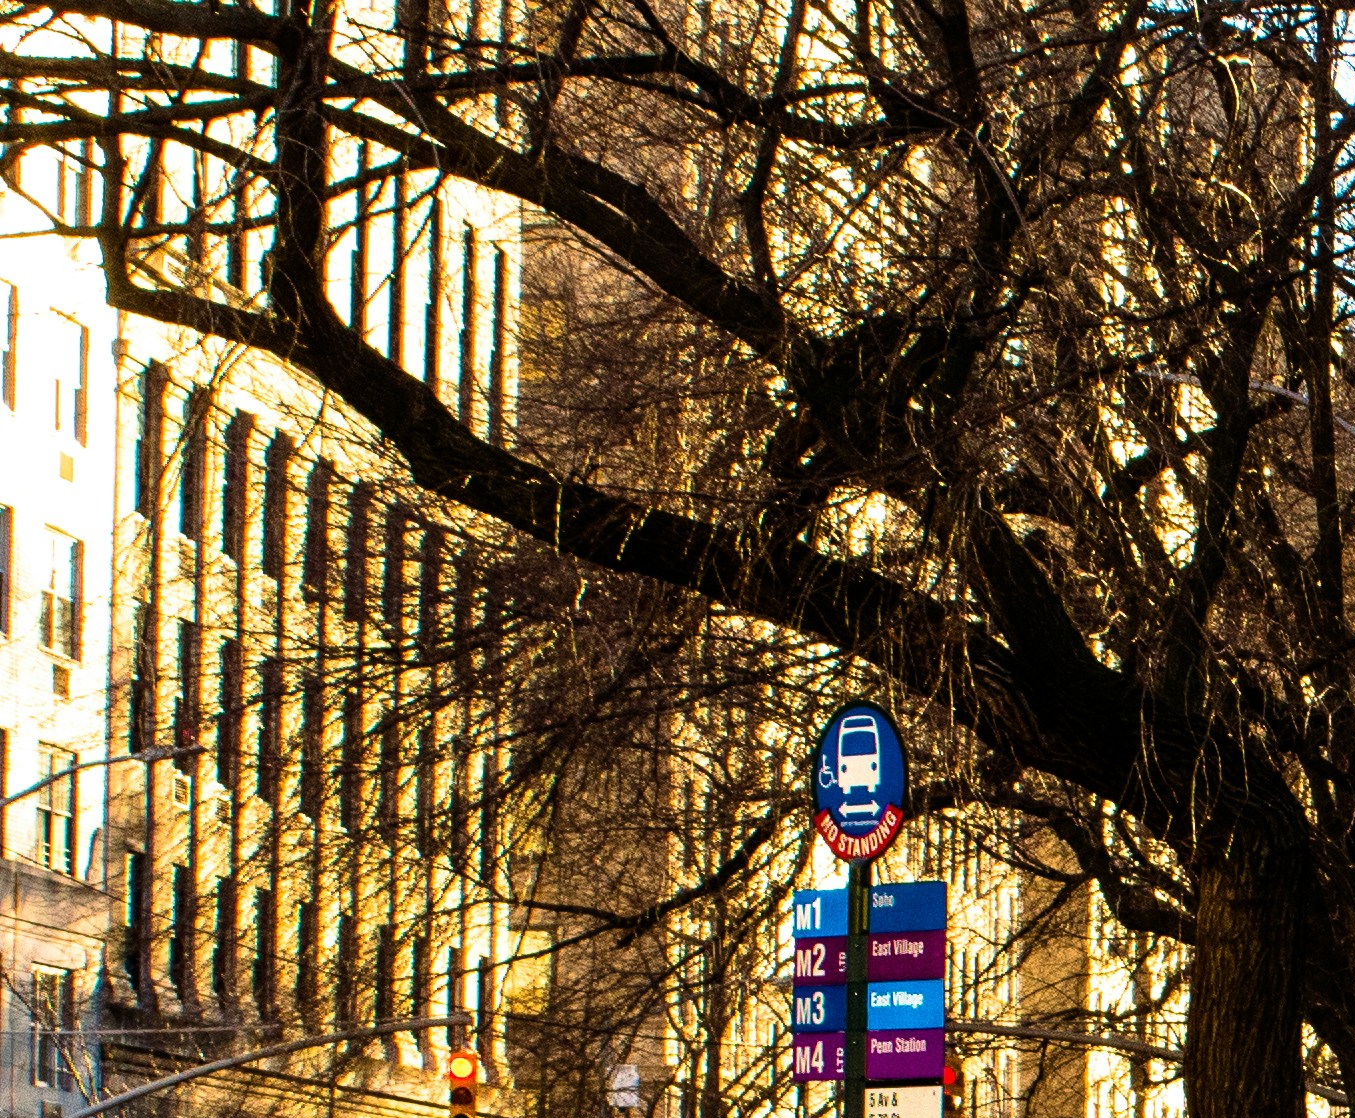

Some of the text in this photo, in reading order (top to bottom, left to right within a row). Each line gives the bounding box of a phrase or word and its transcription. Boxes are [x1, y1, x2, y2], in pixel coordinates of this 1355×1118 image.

[821, 811, 897, 856] NO STANDING
[796, 897, 821, 930] M1
[796, 943, 826, 977] M2
[871, 939, 924, 958] East Village
[796, 991, 825, 1025] M3
[870, 992, 923, 1009] East Village
[795, 1041, 824, 1074] M4
[870, 1037, 927, 1055] Penn Station
[869, 1093, 875, 1107] 5
